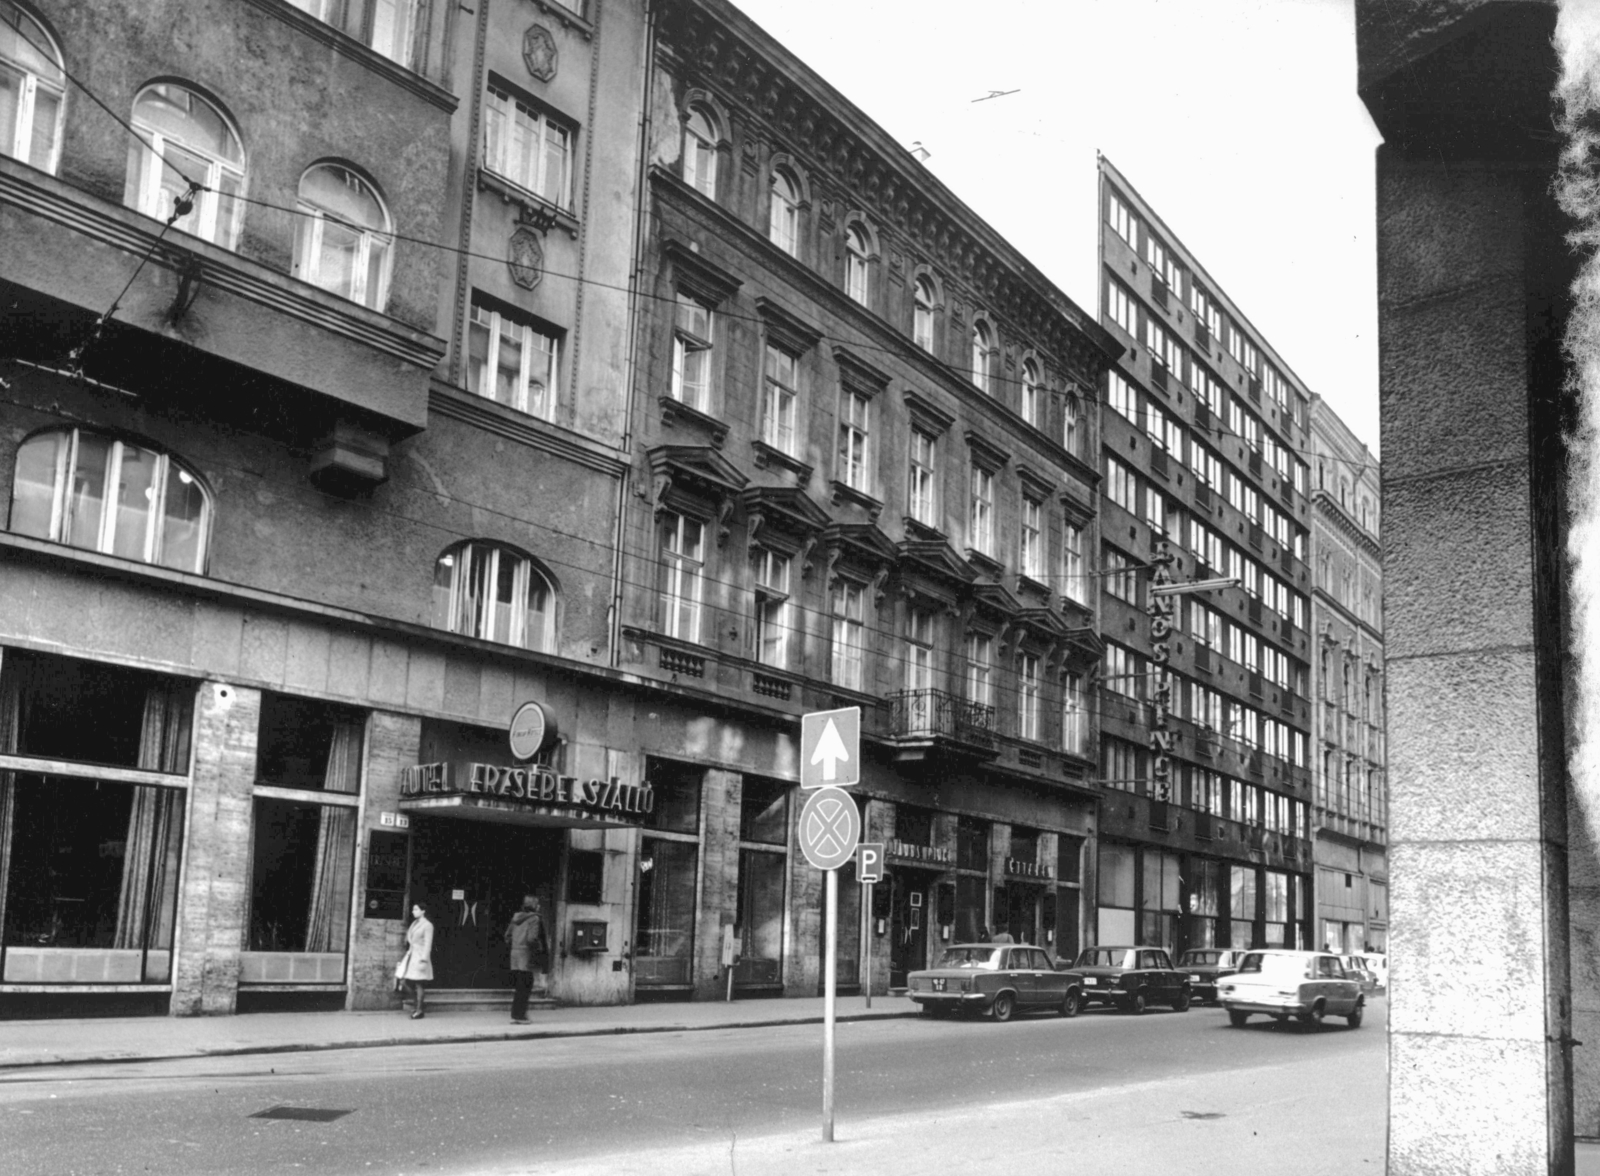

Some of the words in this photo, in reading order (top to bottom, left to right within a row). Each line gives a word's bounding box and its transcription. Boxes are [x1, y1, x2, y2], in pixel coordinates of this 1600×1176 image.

[401, 762, 450, 794] HOTEL
[470, 762, 580, 804] ERZSÉBET
[583, 776, 655, 814] SZÁLLÓ
[862, 850, 877, 875] P
